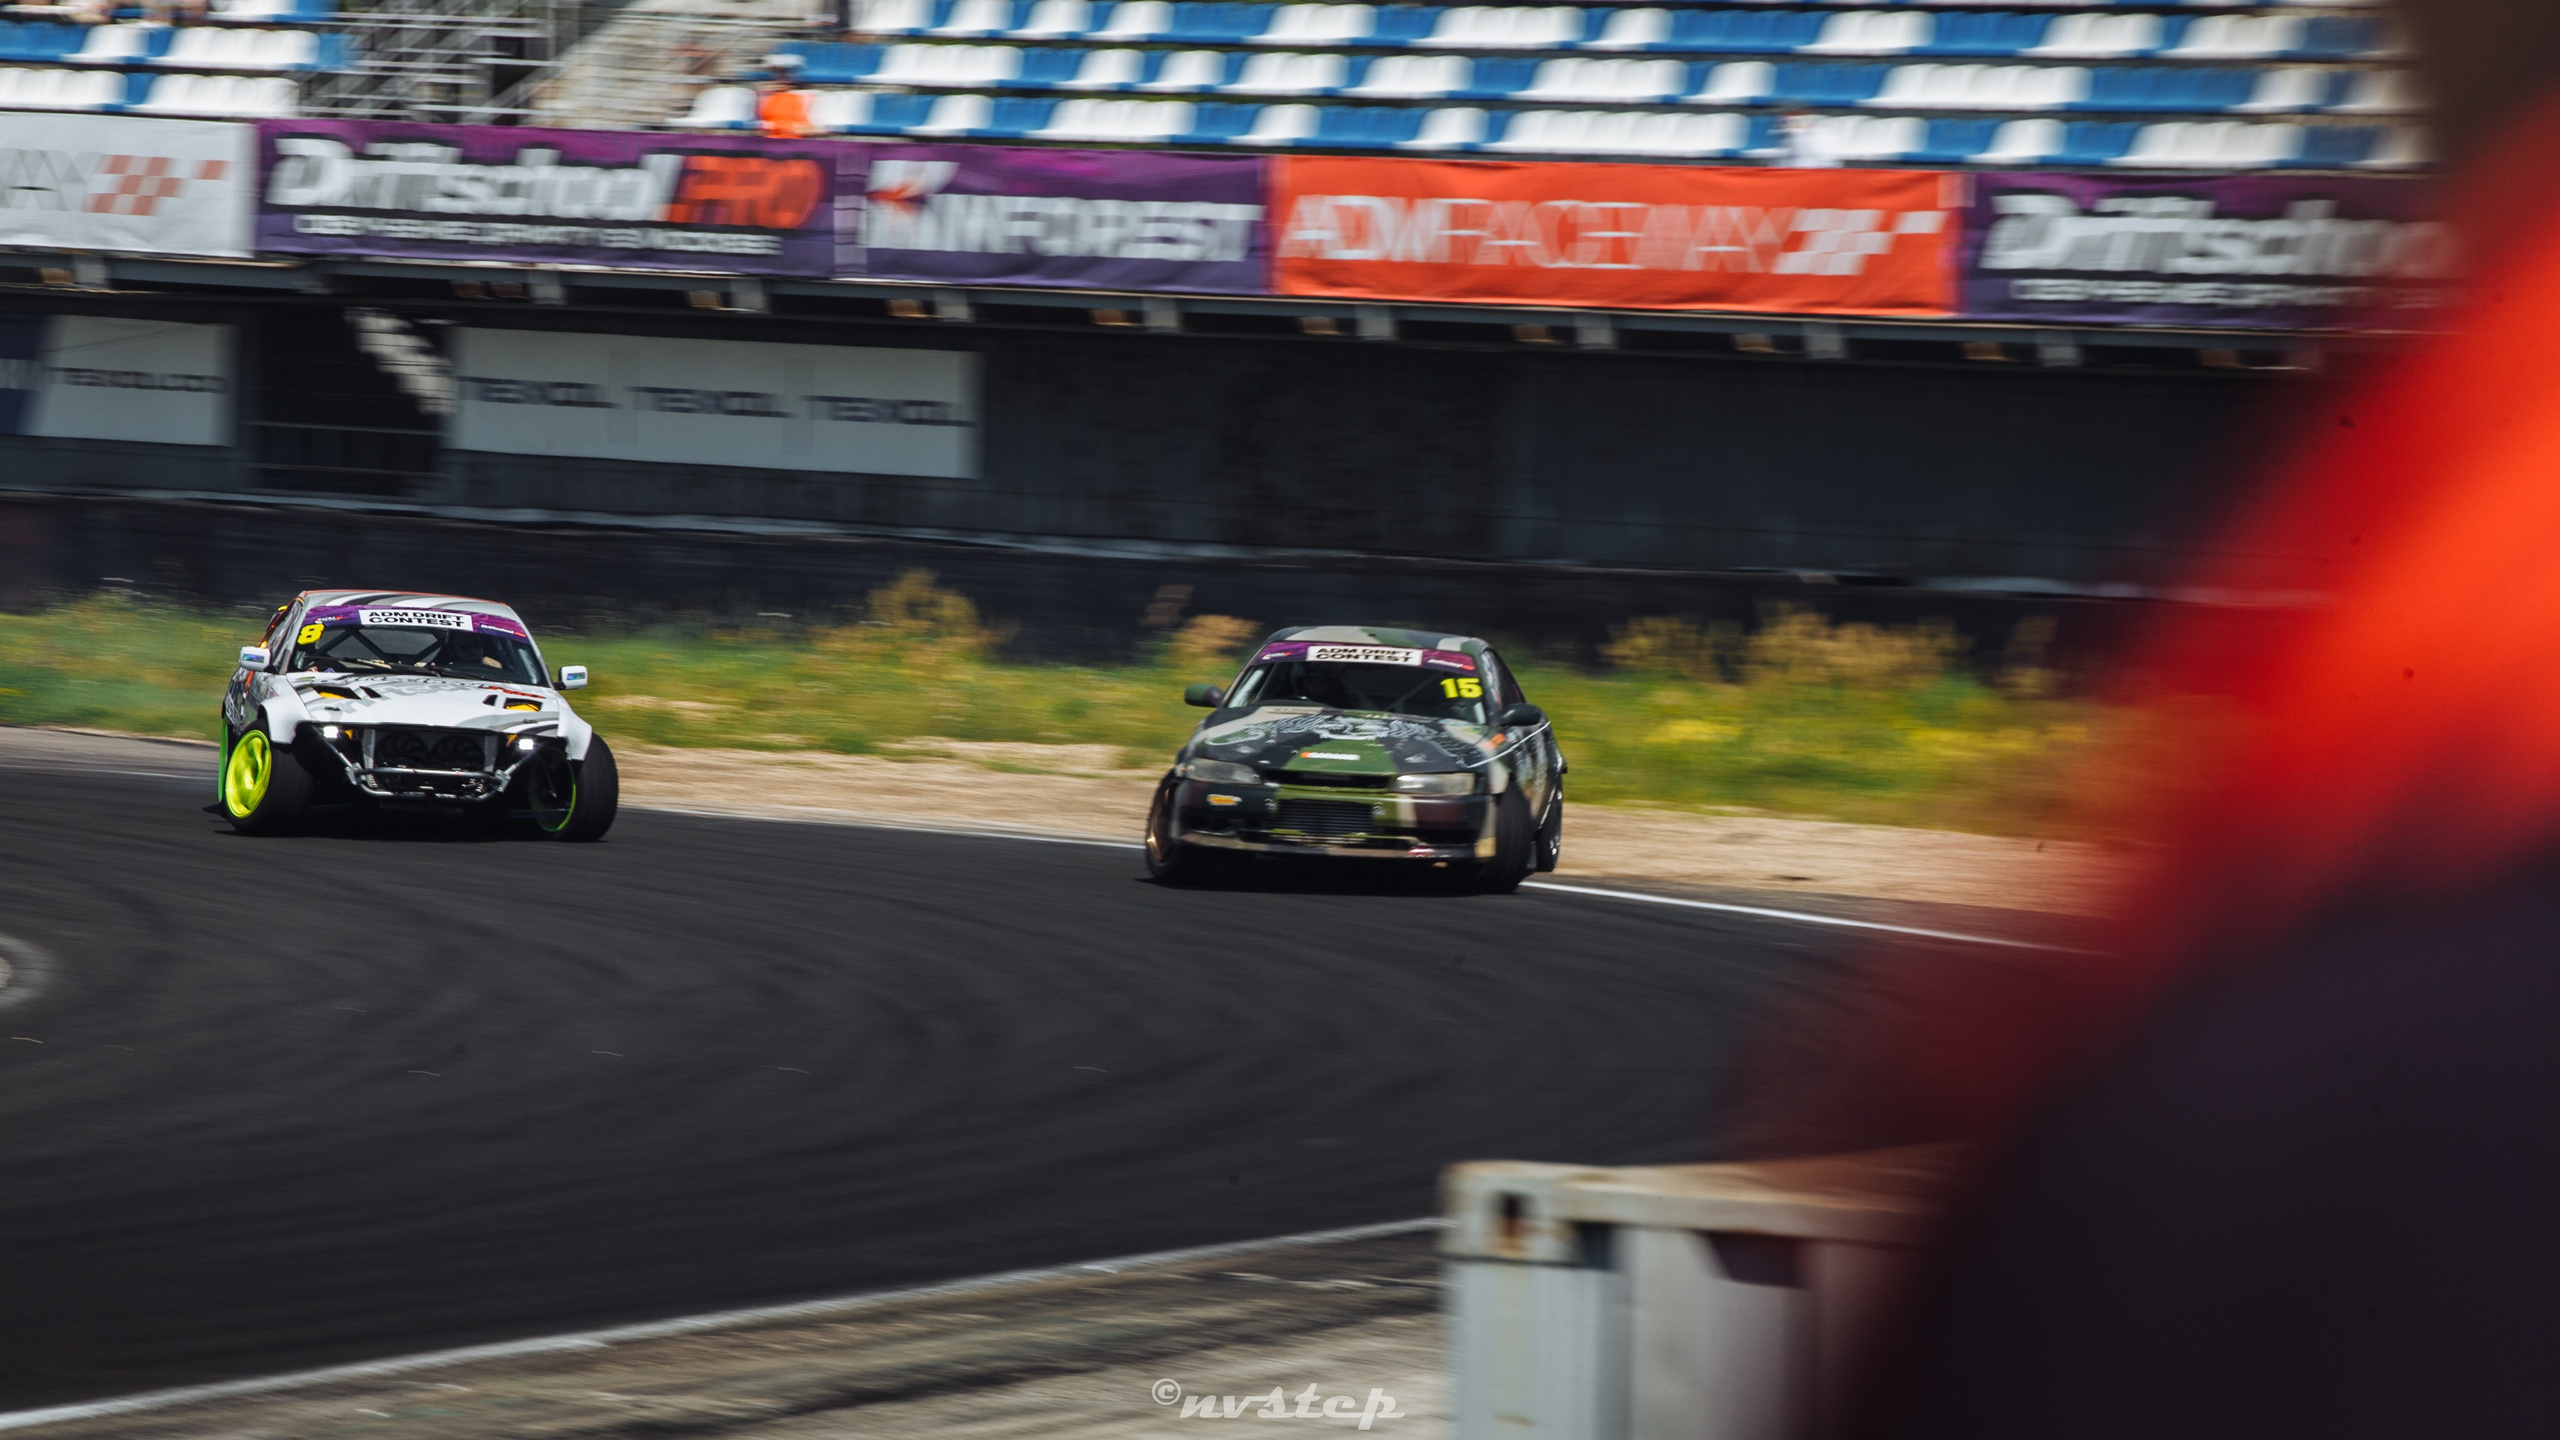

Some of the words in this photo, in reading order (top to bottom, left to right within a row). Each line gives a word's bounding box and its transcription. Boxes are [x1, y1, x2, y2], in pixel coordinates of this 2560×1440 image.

[412, 612, 464, 621] DRIFT
[368, 617, 464, 627] CONTEST
[297, 623, 325, 645] 8
[1316, 654, 1413, 662] CONTEST
[1440, 677, 1483, 698] 15
